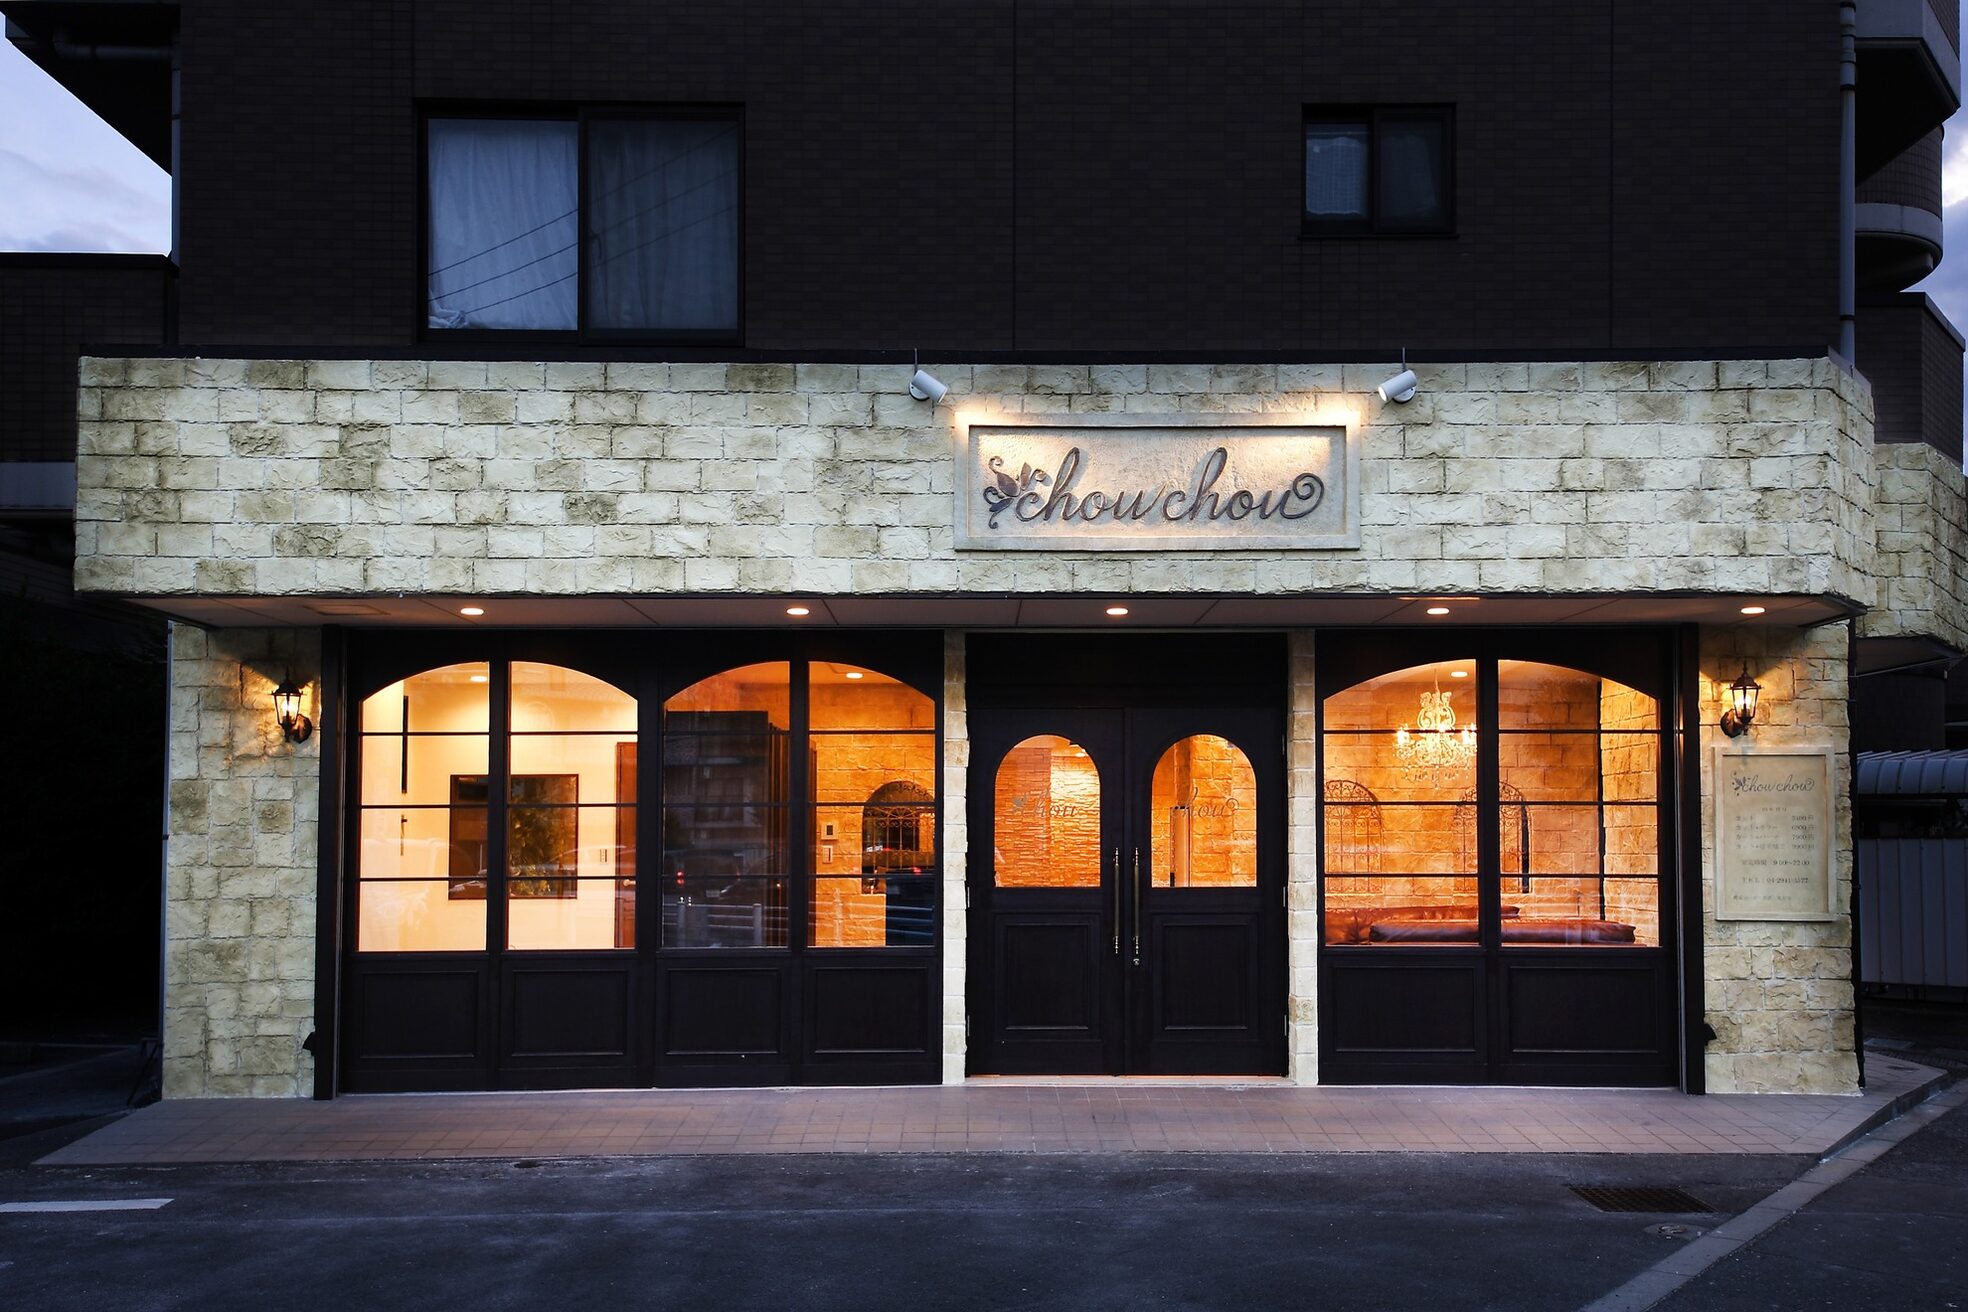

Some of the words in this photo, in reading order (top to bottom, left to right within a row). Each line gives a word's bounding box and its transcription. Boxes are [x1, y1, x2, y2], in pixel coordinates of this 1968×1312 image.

[1014, 447, 1166, 522] chou
[1162, 447, 1325, 521] chou
[1741, 774, 1775, 792] chou
[1775, 774, 1815, 792] chou
